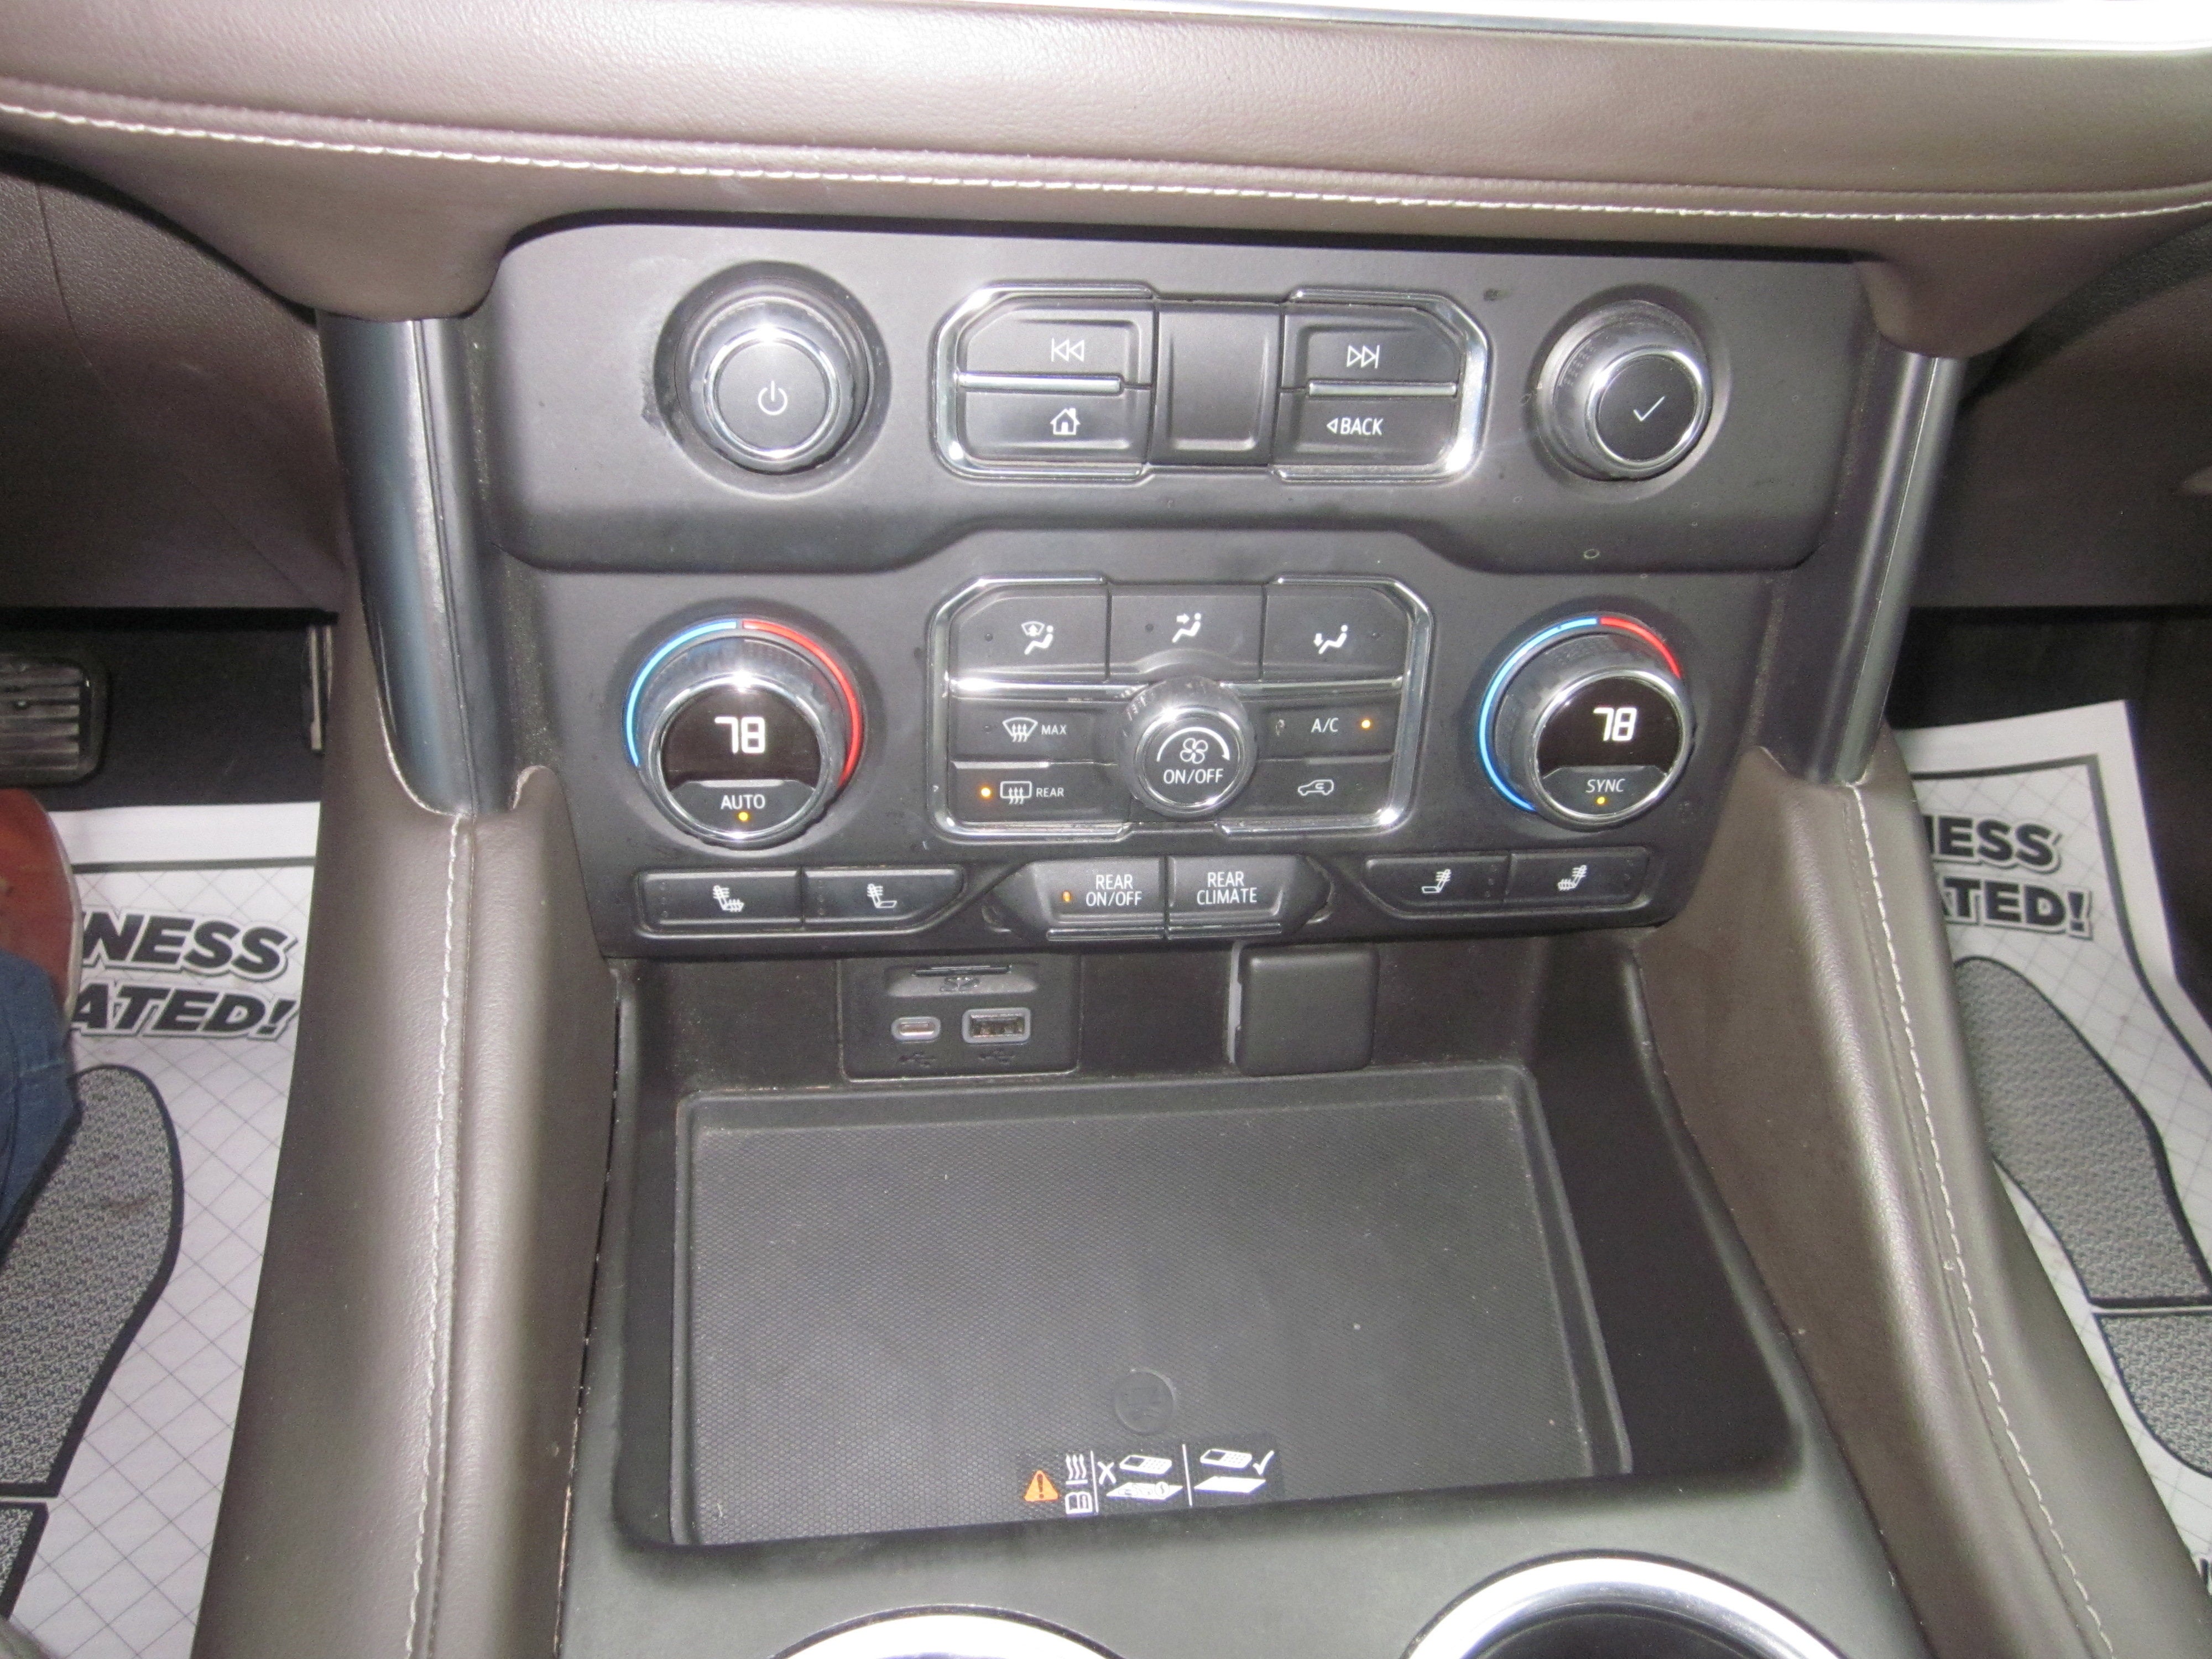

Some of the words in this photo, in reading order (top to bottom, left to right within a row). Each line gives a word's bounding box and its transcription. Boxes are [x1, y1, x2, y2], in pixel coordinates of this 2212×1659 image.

[1339, 416, 1384, 436] BACK
[1041, 723, 1067, 736] MAX
[1311, 717, 1339, 733] A/C
[1593, 706, 1638, 742] 78
[714, 716, 766, 754] 78
[1162, 767, 1224, 785] ON/OFF
[1036, 786, 1065, 799] REAR
[1585, 778, 1626, 794] SYNC
[720, 793, 766, 810] AUTO
[1095, 873, 1134, 890] REAR
[1207, 870, 1245, 888] REAR
[1085, 889, 1142, 907] ON/OFF
[1196, 887, 1258, 906] CLIMATE
[1942, 877, 2086, 932] TED!
[82, 911, 289, 975] NESS
